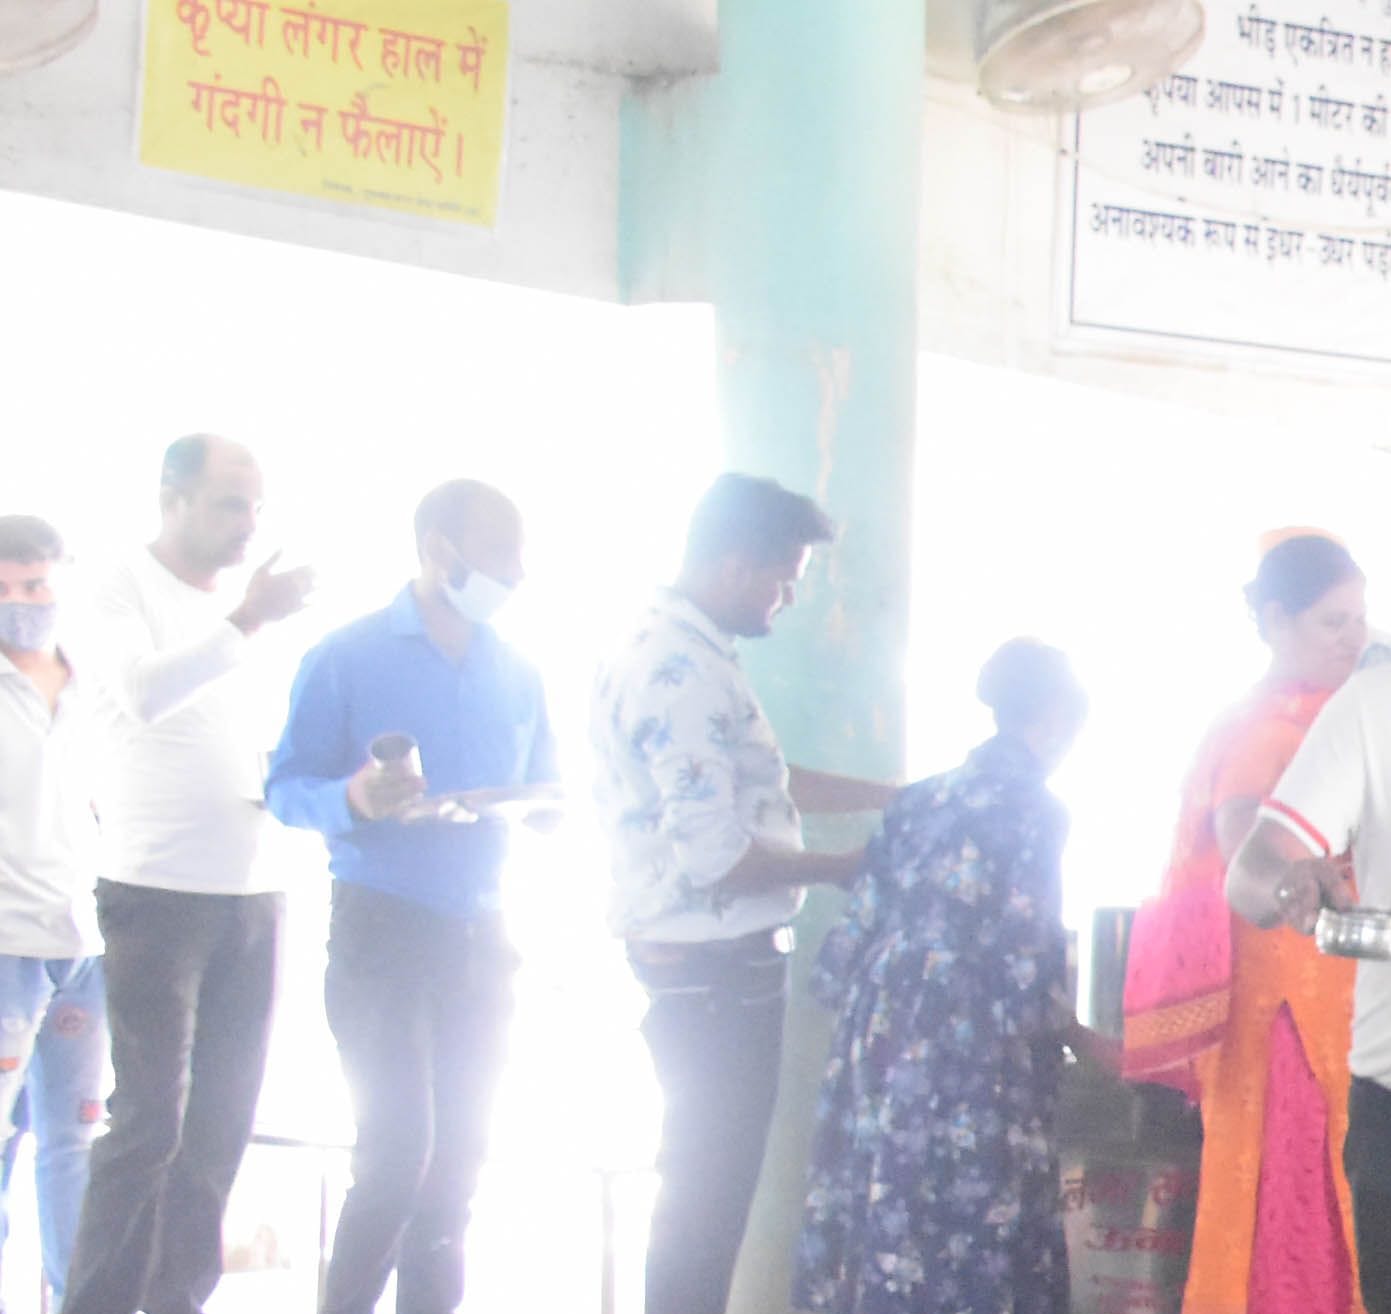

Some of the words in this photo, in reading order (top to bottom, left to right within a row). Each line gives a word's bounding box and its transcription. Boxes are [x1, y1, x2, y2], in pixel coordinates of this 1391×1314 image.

[378, 27, 447, 84] हाल
[456, 25, 489, 93] में
[186, 72, 288, 146] गंदगी
[298, 102, 329, 152] न
